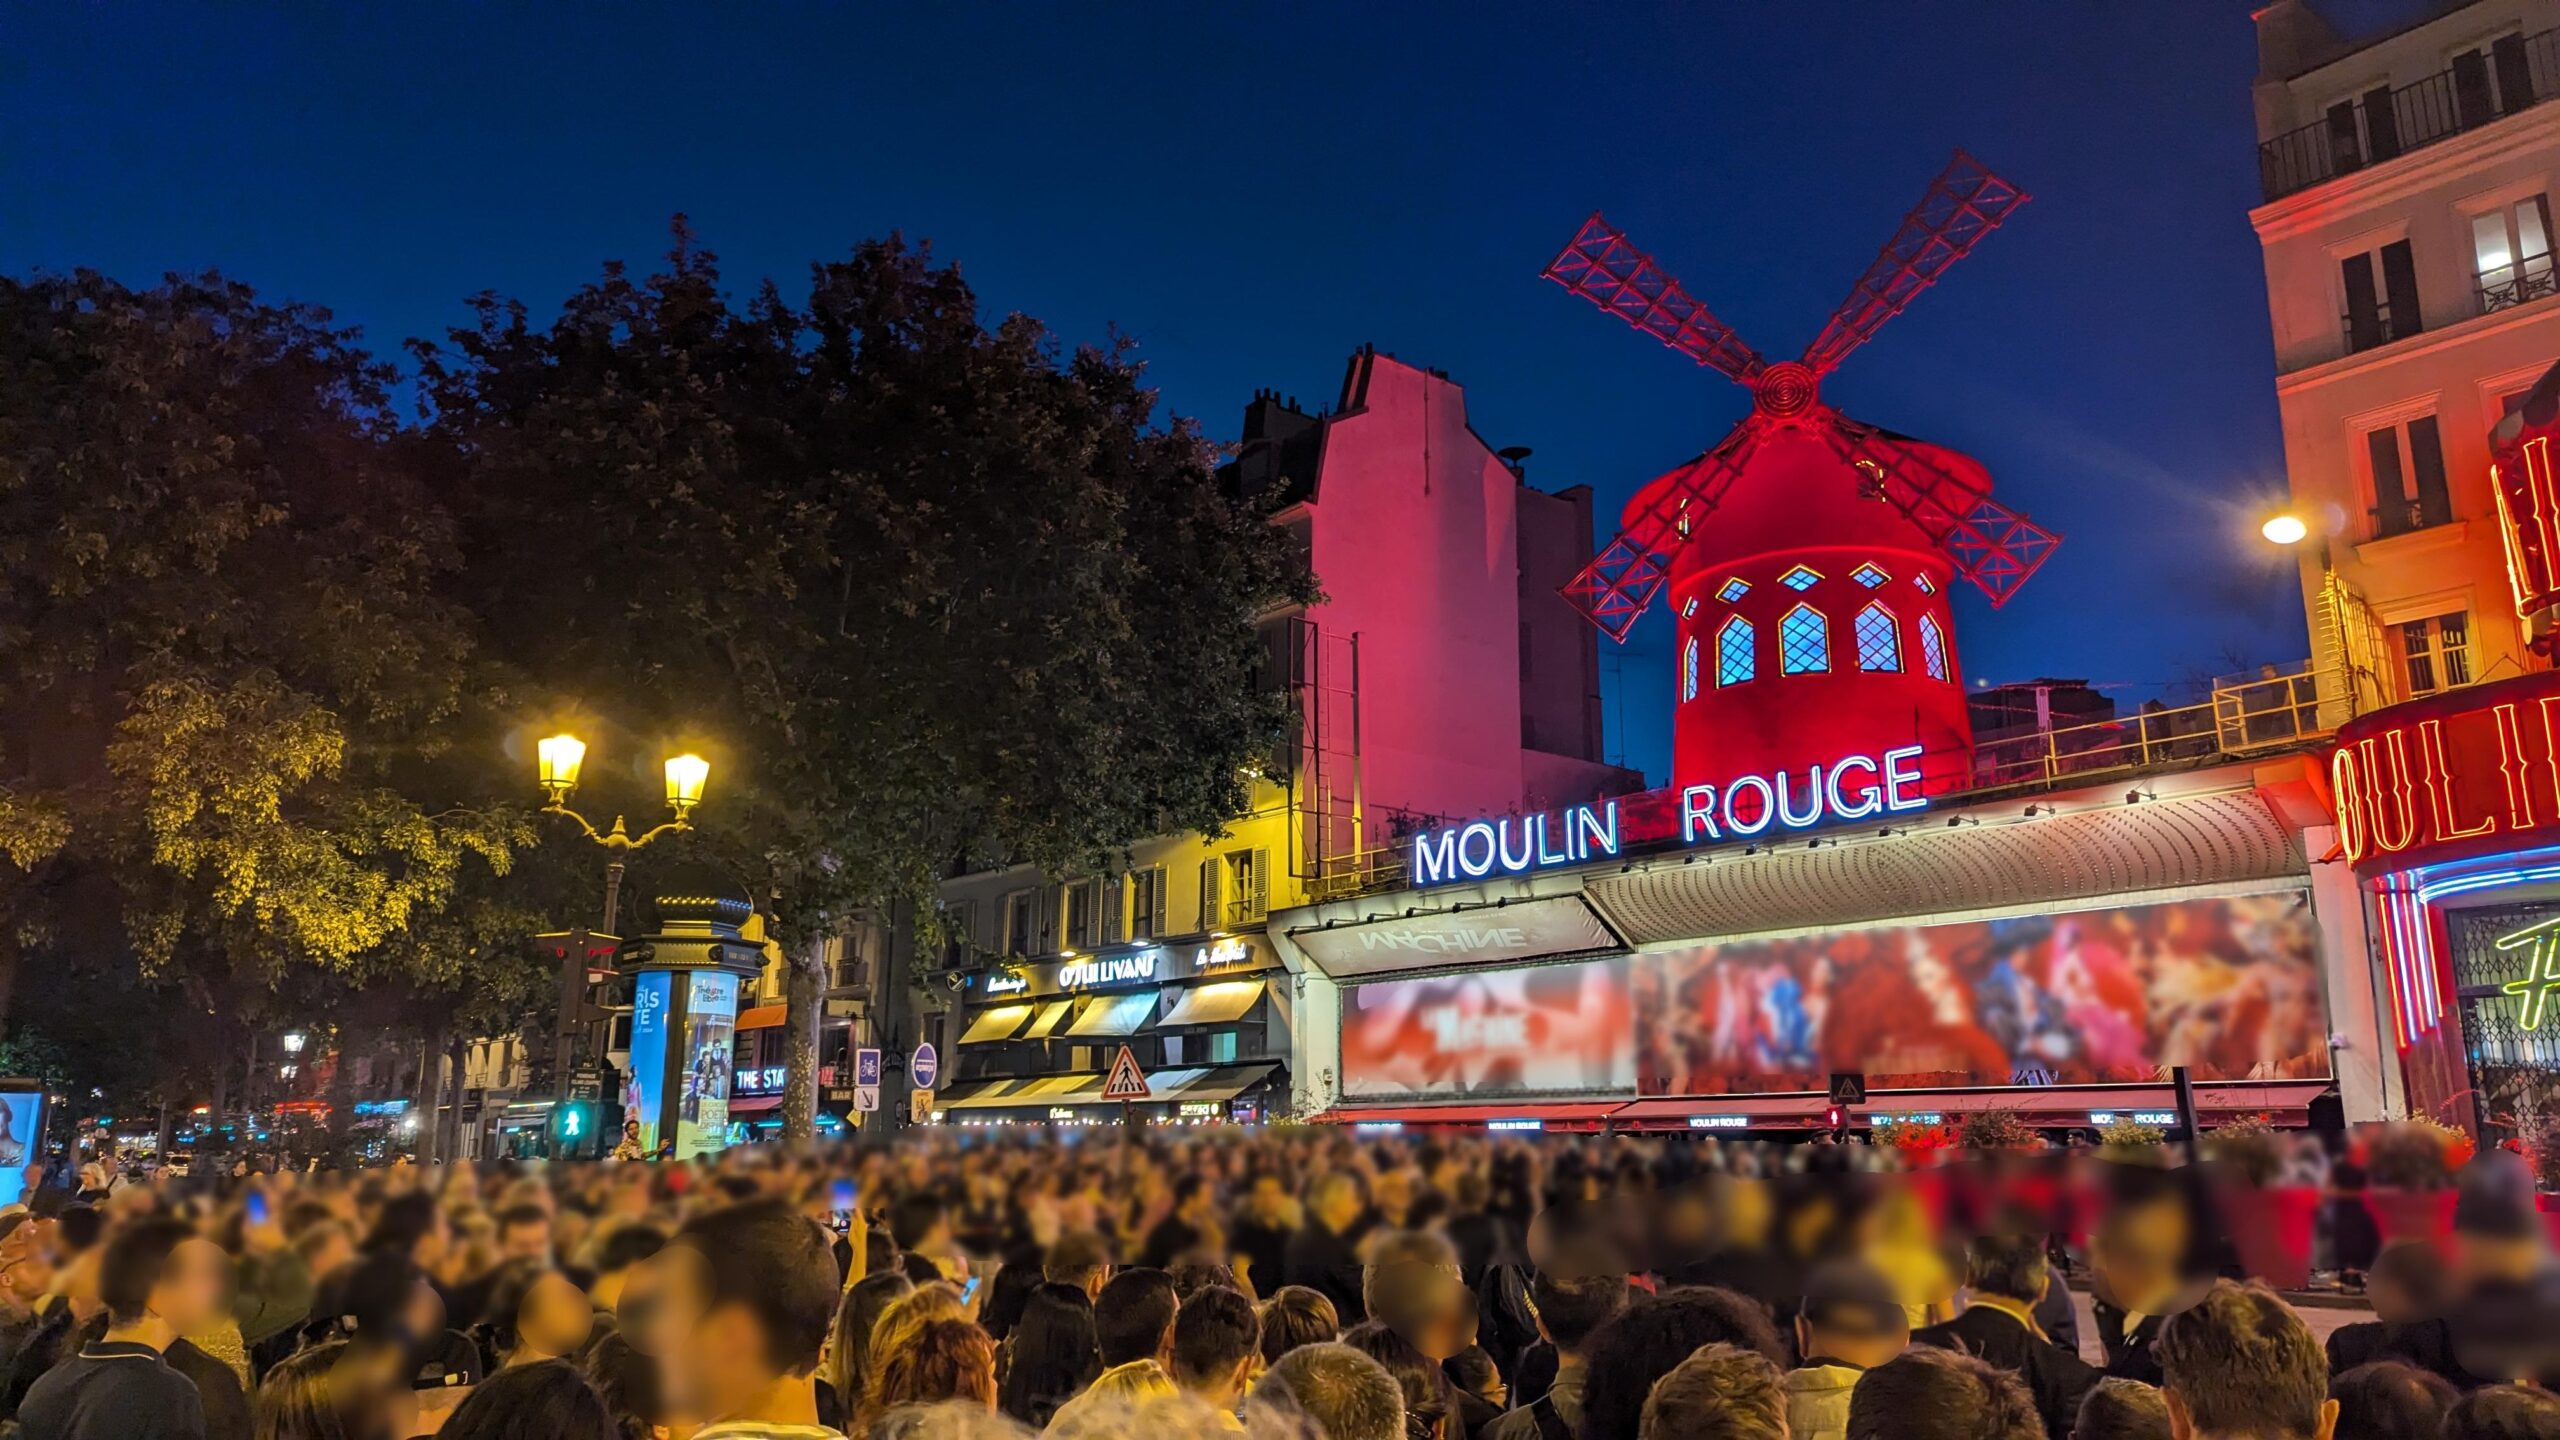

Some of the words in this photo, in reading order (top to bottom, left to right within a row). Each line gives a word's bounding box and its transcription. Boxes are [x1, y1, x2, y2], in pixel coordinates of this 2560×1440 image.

[1414, 802, 1618, 884] MOULIN
[1682, 745, 1928, 842] ROUGE
[737, 1070, 758, 1089] THE
[764, 1068, 786, 1089] STA
[832, 1090, 852, 1101] BAR
[2134, 1114, 2175, 1125] ROUGE
